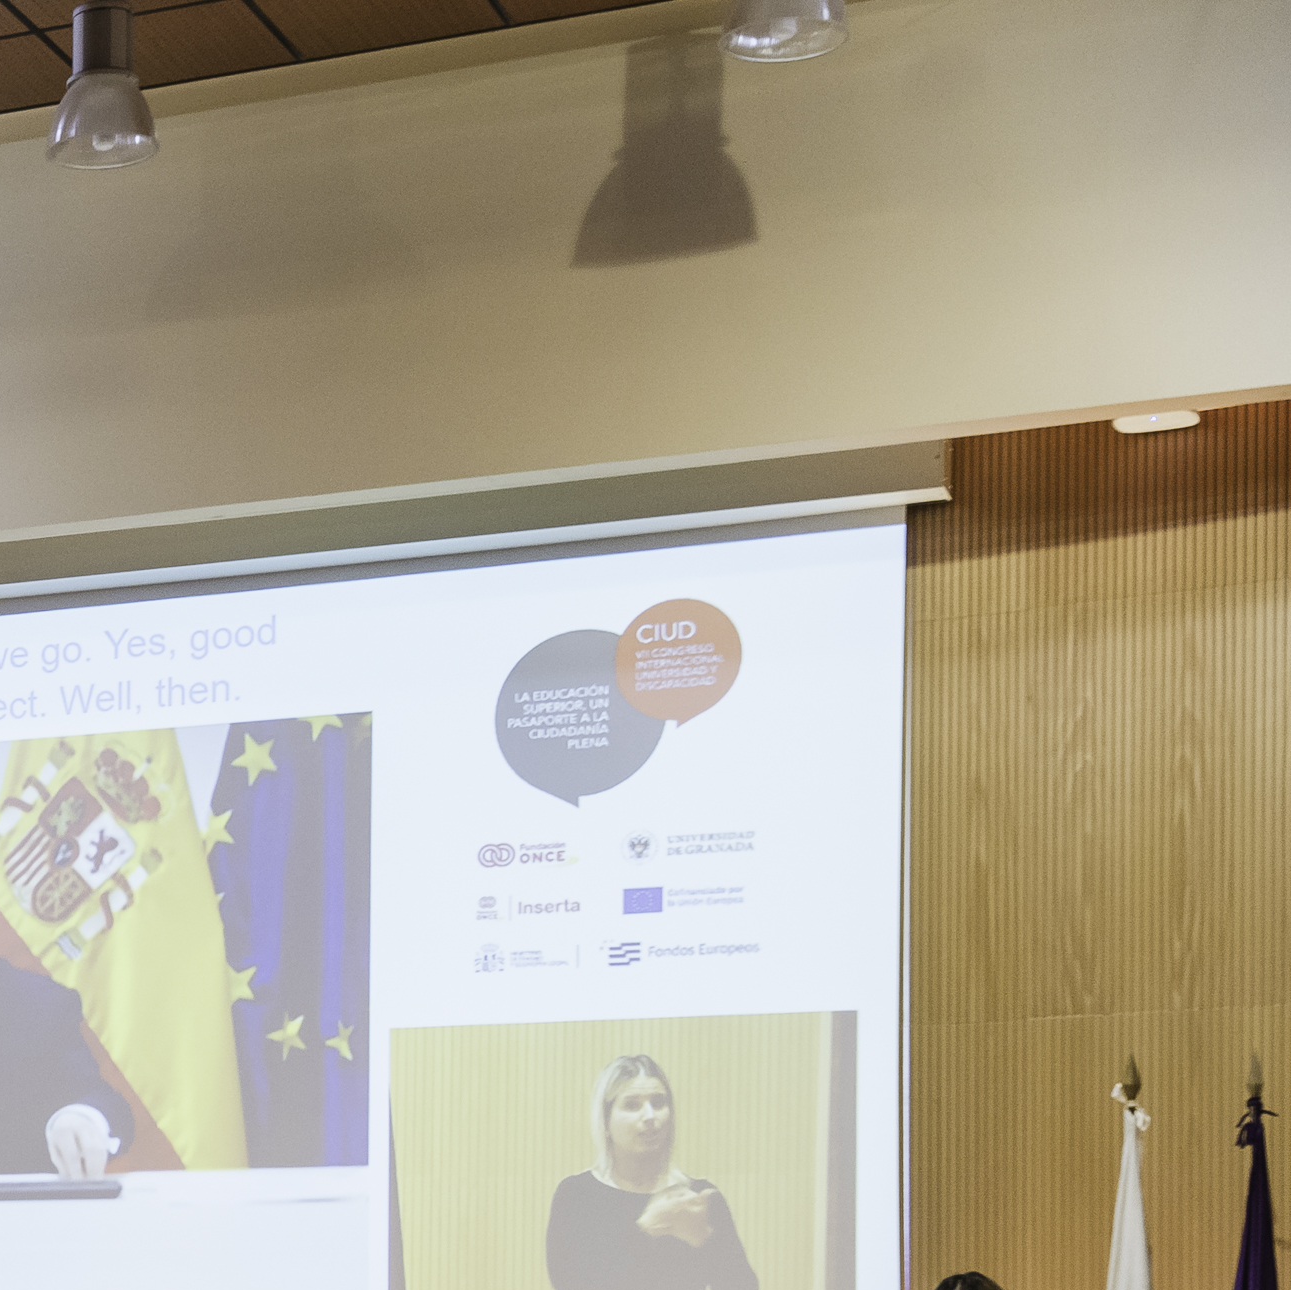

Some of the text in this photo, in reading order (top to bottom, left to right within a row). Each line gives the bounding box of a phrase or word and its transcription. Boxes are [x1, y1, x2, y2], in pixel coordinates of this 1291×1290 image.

[635, 620, 697, 644] CIUD
[41, 641, 91, 673] go.
[104, 628, 175, 660] Yes,
[190, 614, 277, 660] good
[650, 643, 715, 658] CONGRESO
[59, 680, 141, 715] Well,
[155, 676, 240, 708] then.
[514, 684, 610, 703] LA EDUCACIÓN
[589, 697, 610, 708] UN
[507, 711, 610, 728] PASAPORTE A LA
[529, 723, 610, 739] CIUDADANÍA
[567, 737, 610, 749] PLENA
[520, 850, 566, 864] ONCE
[518, 898, 581, 915] Inserta
[648, 942, 759, 957] Fondos Europeos
